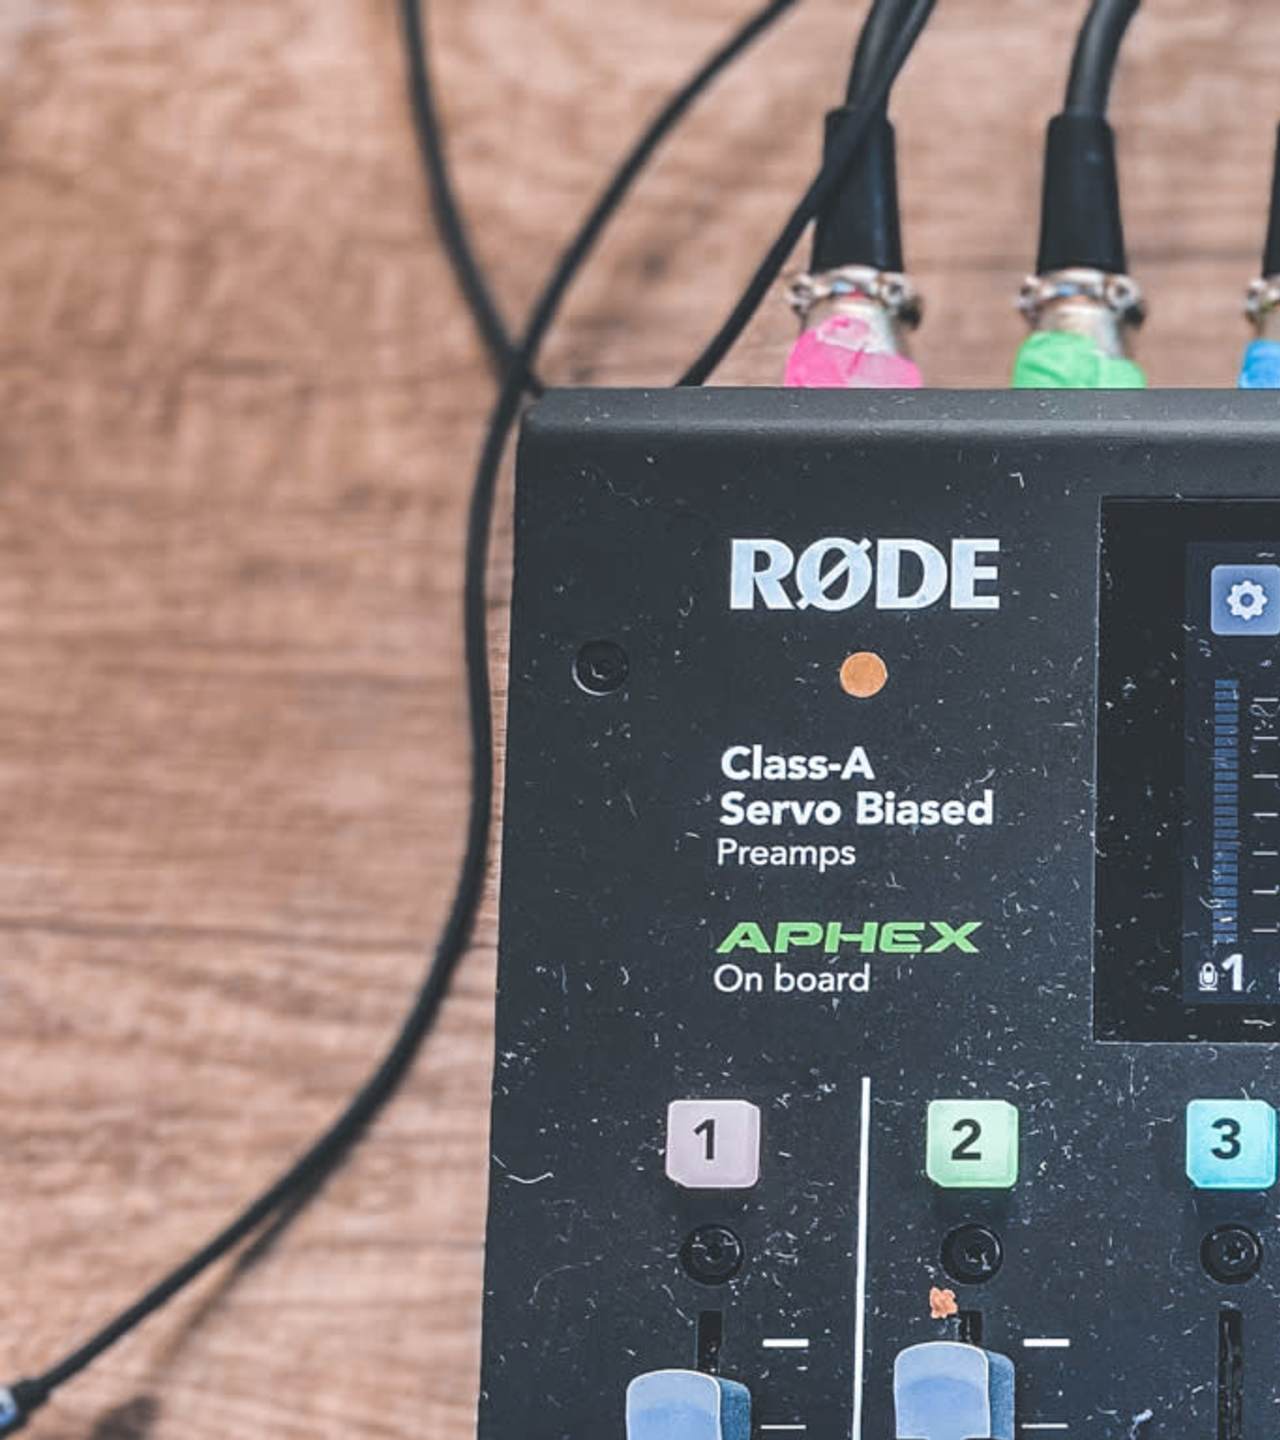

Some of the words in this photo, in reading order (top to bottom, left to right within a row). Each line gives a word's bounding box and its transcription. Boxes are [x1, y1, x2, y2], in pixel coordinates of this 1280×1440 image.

[729, 537, 1000, 611] RØDE
[720, 745, 876, 781] Class-A
[719, 790, 843, 826] Servo
[856, 789, 994, 826] Biased
[717, 838, 856, 873] Preamps
[715, 921, 983, 954] APHEX
[713, 963, 763, 993] On
[774, 962, 871, 993] board
[1219, 954, 1244, 992] 1
[693, 1119, 716, 1160] 1
[951, 1119, 982, 1160] 2
[1211, 1118, 1241, 1160] 3
